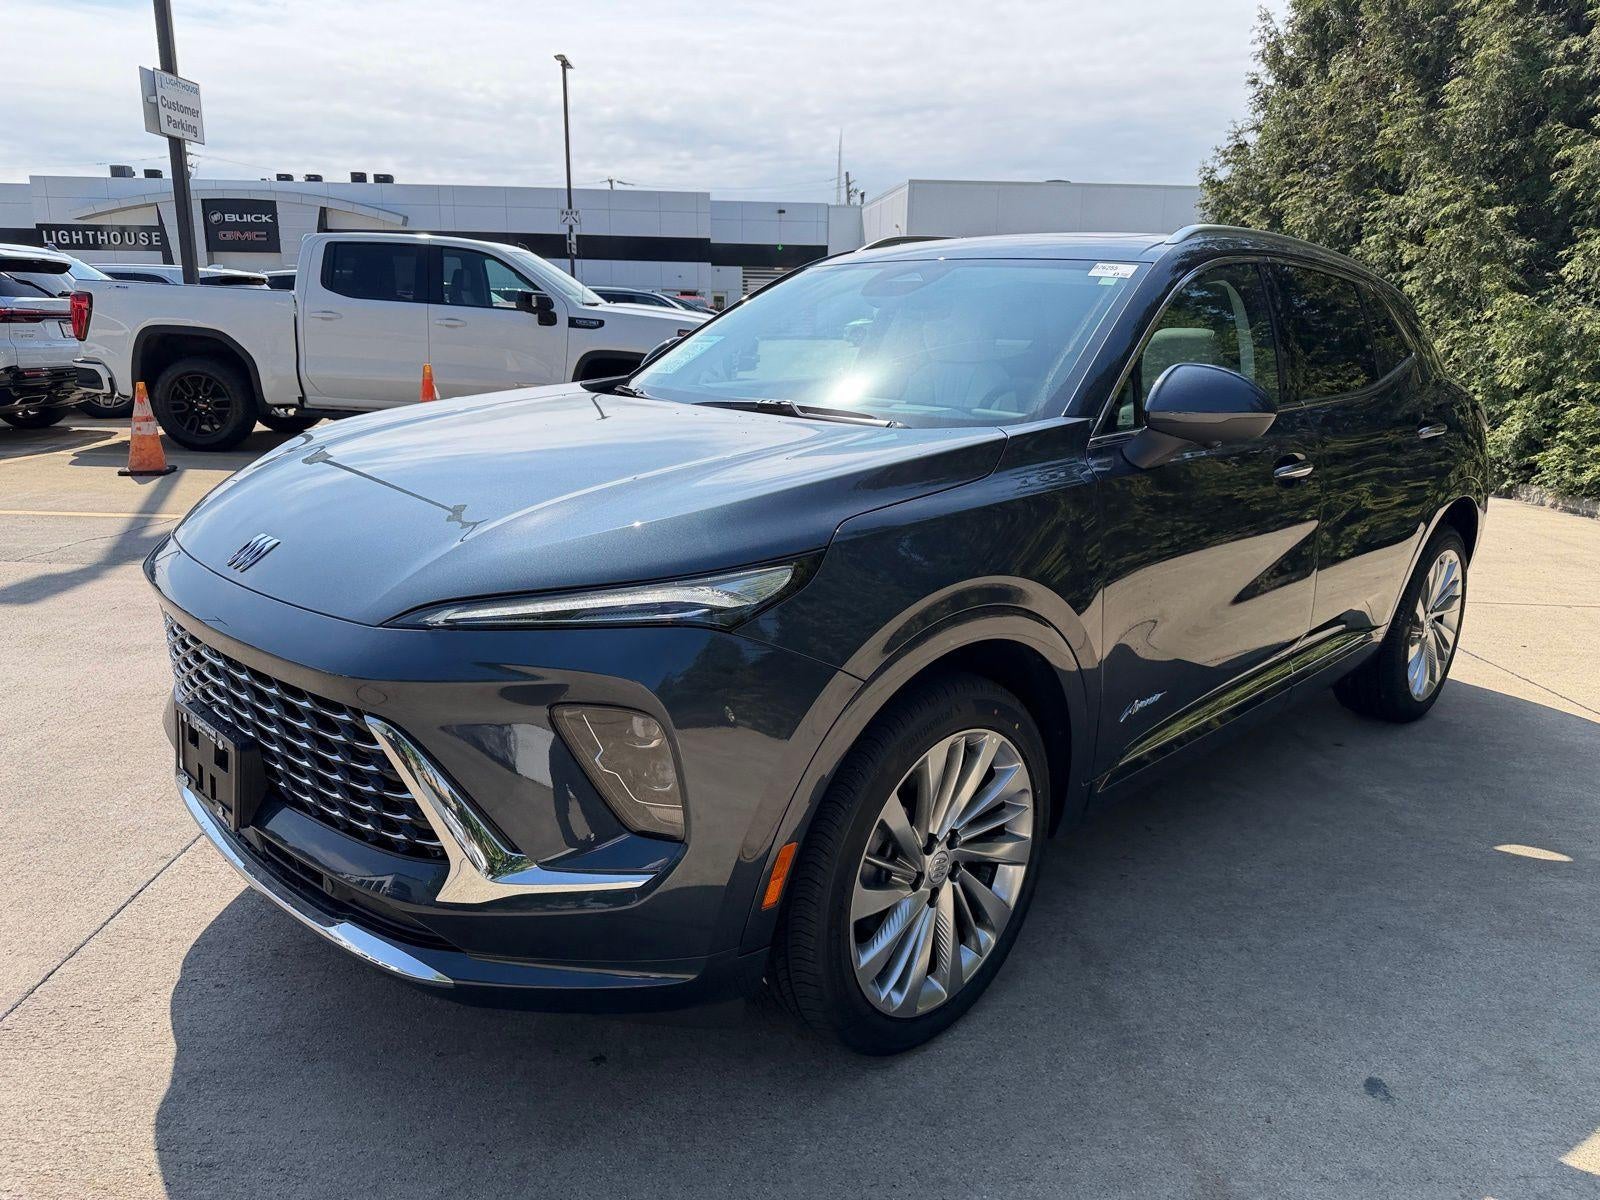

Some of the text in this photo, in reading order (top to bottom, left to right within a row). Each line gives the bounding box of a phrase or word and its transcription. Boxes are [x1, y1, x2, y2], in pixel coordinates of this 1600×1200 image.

[161, 95, 200, 119] Customer
[166, 114, 198, 138] Parking
[224, 213, 274, 223] BUICK
[42, 229, 162, 246] LIGHTHOUSE
[218, 230, 268, 241] GMC
